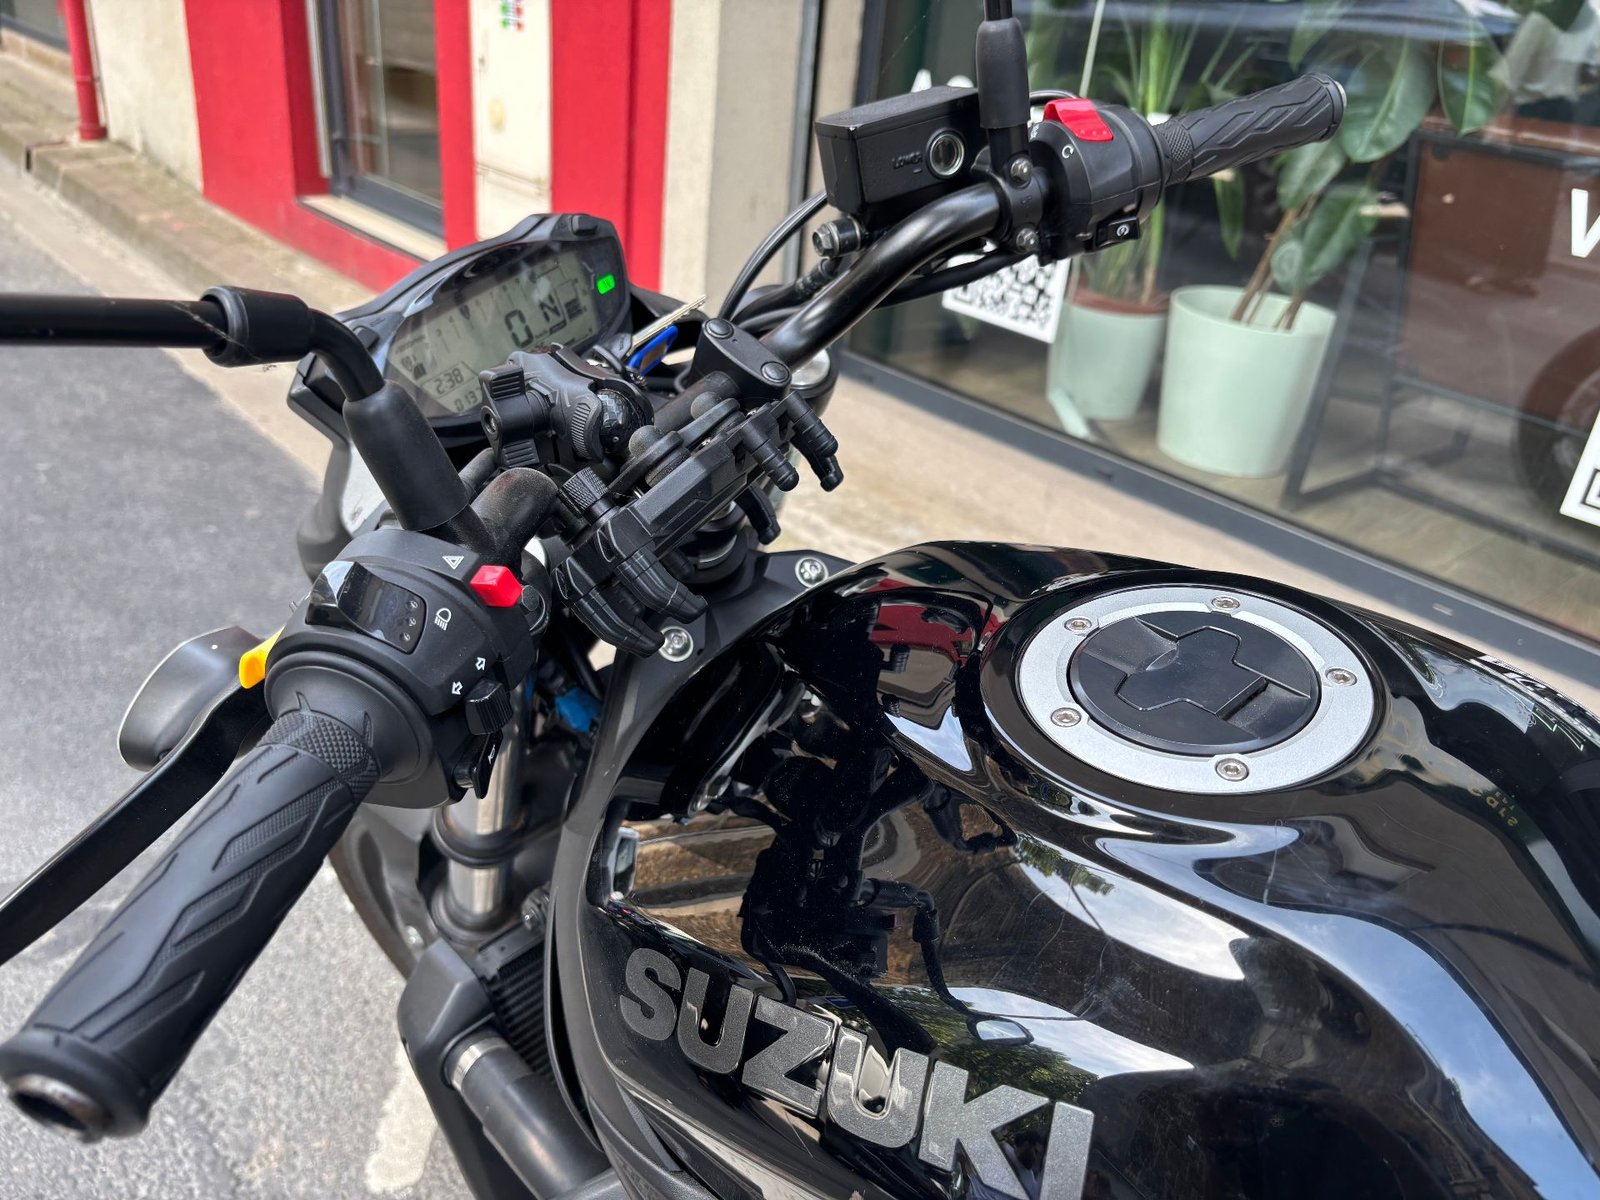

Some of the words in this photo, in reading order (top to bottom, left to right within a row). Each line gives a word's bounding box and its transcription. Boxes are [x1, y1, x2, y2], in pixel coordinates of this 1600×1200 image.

[540, 293, 561, 322] N
[505, 310, 533, 348] 0
[620, 947, 1095, 1200] SUZUKI
